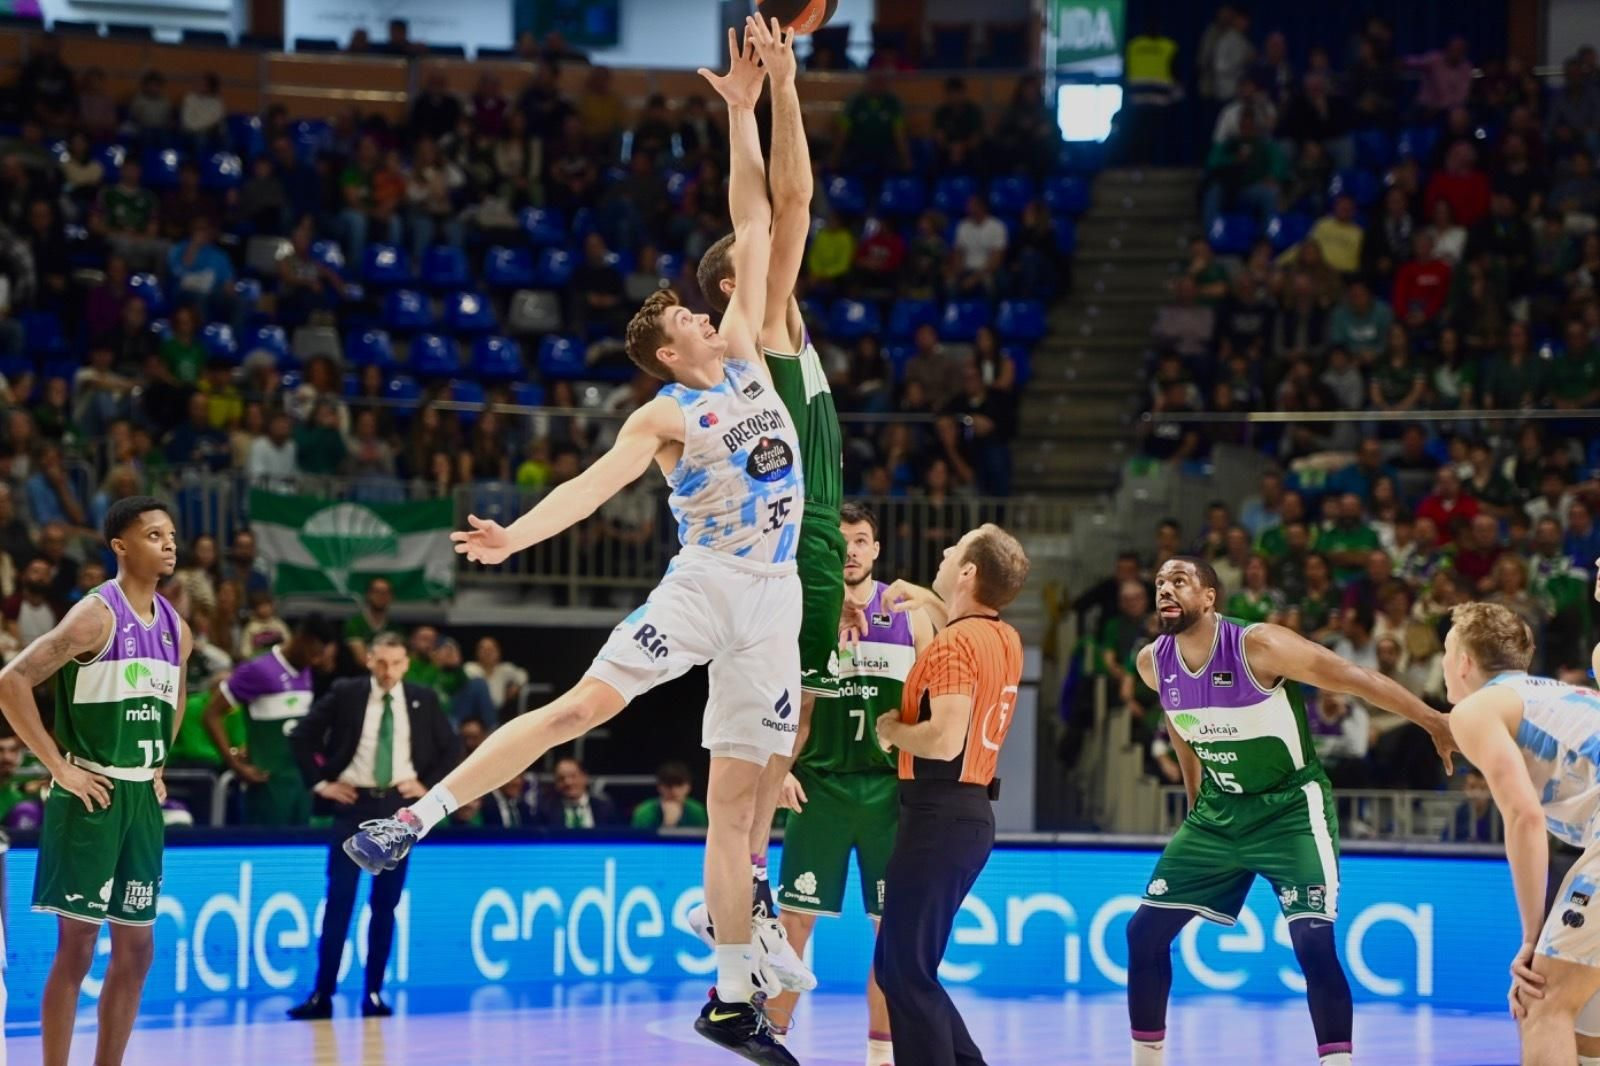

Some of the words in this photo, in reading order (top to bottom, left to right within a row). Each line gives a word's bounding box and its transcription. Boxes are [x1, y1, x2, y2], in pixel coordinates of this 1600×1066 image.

[754, 445, 785, 465] Estrella
[757, 455, 788, 474] Galicia
[852, 657, 889, 670] Unicaja
[849, 709, 865, 741] 7
[1199, 723, 1238, 735] Unicaja
[138, 740, 165, 768] 11
[1206, 766, 1243, 794] 15
[471, 857, 813, 981] endes
